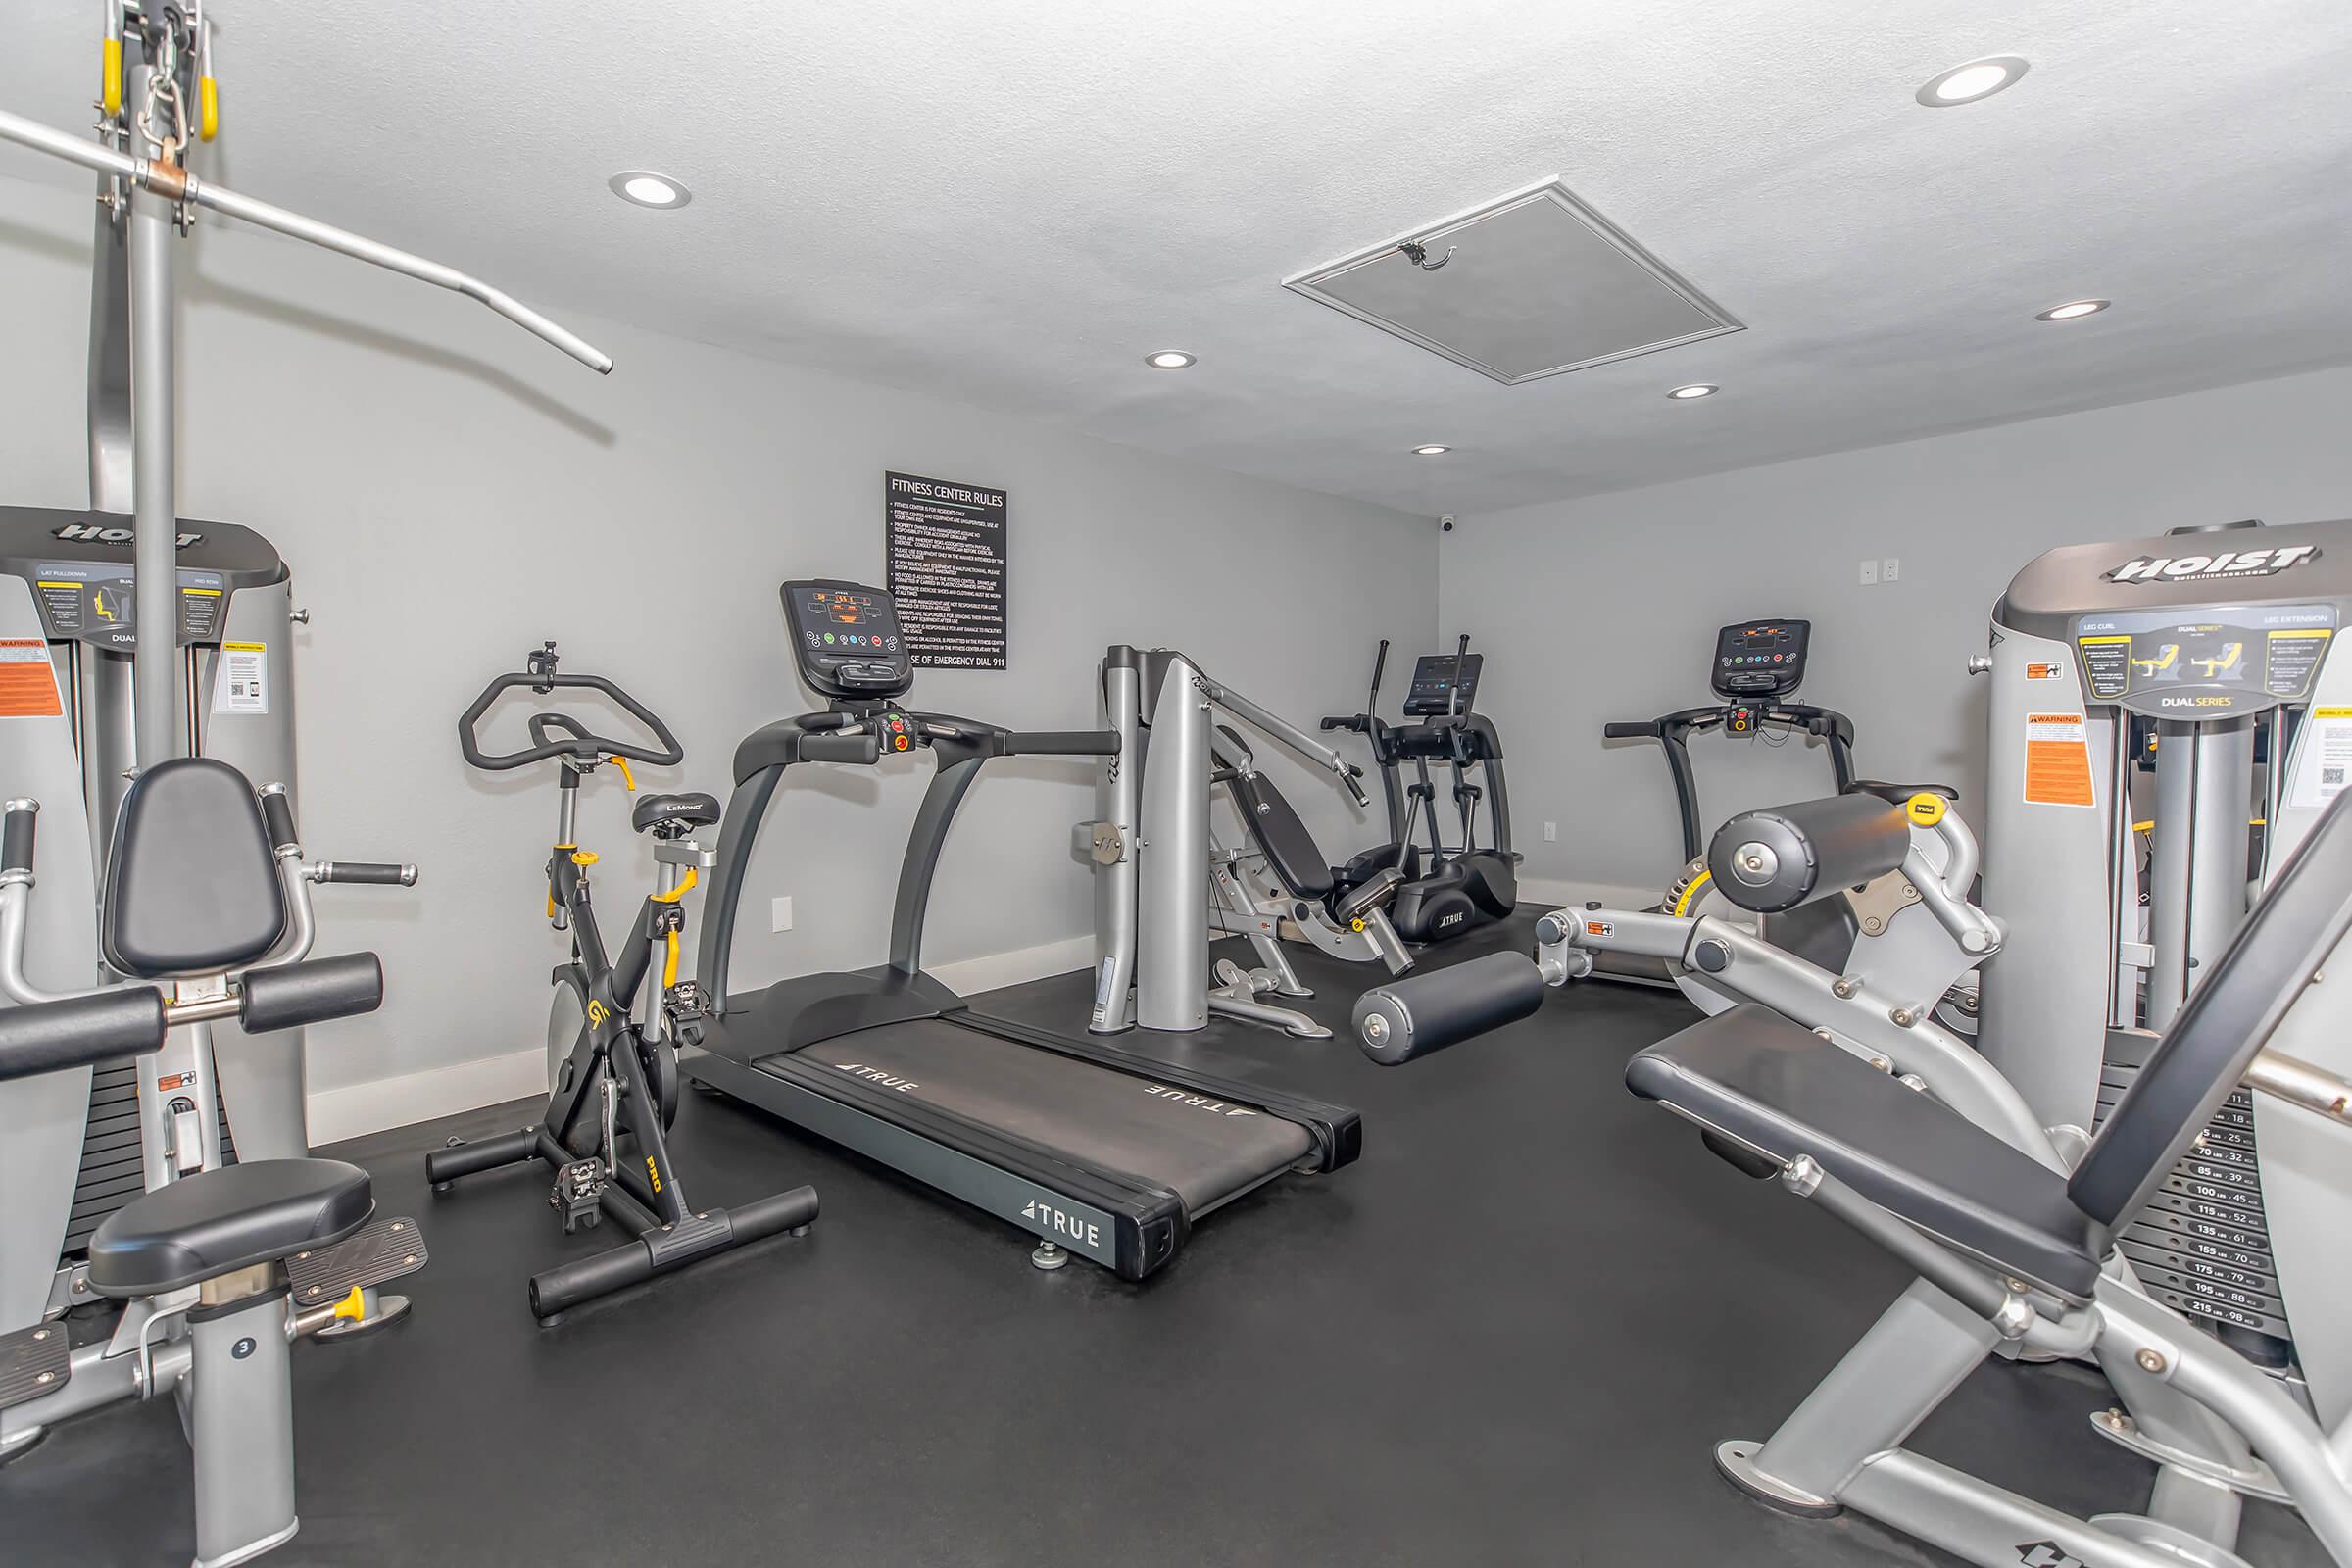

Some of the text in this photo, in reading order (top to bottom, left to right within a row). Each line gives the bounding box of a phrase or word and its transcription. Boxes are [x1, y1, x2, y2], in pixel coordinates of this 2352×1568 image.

[892, 478, 1003, 507] FITNESS CENTER RULES
[57, 524, 203, 546] HOT
[2112, 546, 2314, 580] HOIST
[2264, 614, 2328, 624] LEG EXTENSION
[910, 655, 919, 663] SE
[934, 656, 973, 665] EMERGENCY
[856, 1067, 920, 1092] TRUE
[1144, 1085, 1224, 1112] TRUE
[2232, 1114, 2244, 1123] 18
[2228, 1133, 2241, 1143] 25
[2198, 1147, 2212, 1156] 70
[2230, 1152, 2242, 1162] 32
[646, 1155, 662, 1193] PRO
[2197, 1166, 2211, 1176] 85
[2230, 1172, 2242, 1182] 39
[2196, 1186, 2216, 1197] 100
[2233, 1194, 2246, 1202] 45
[2198, 1205, 2216, 1216] 115
[2233, 1213, 2247, 1223] 52
[1038, 1203, 1100, 1248] TRUE
[2197, 1224, 2216, 1236] 135
[2233, 1234, 2245, 1243] 61
[2198, 1244, 2216, 1255] 155
[2235, 1253, 2248, 1263] 70
[2194, 1263, 2213, 1275] 175
[2231, 1272, 2244, 1282] 79
[2195, 1283, 2214, 1295] 195
[2231, 1293, 2245, 1302] 88
[2192, 1301, 2212, 1313] 215
[2230, 1311, 2243, 1322] 98
[239, 1341, 249, 1353] 3
